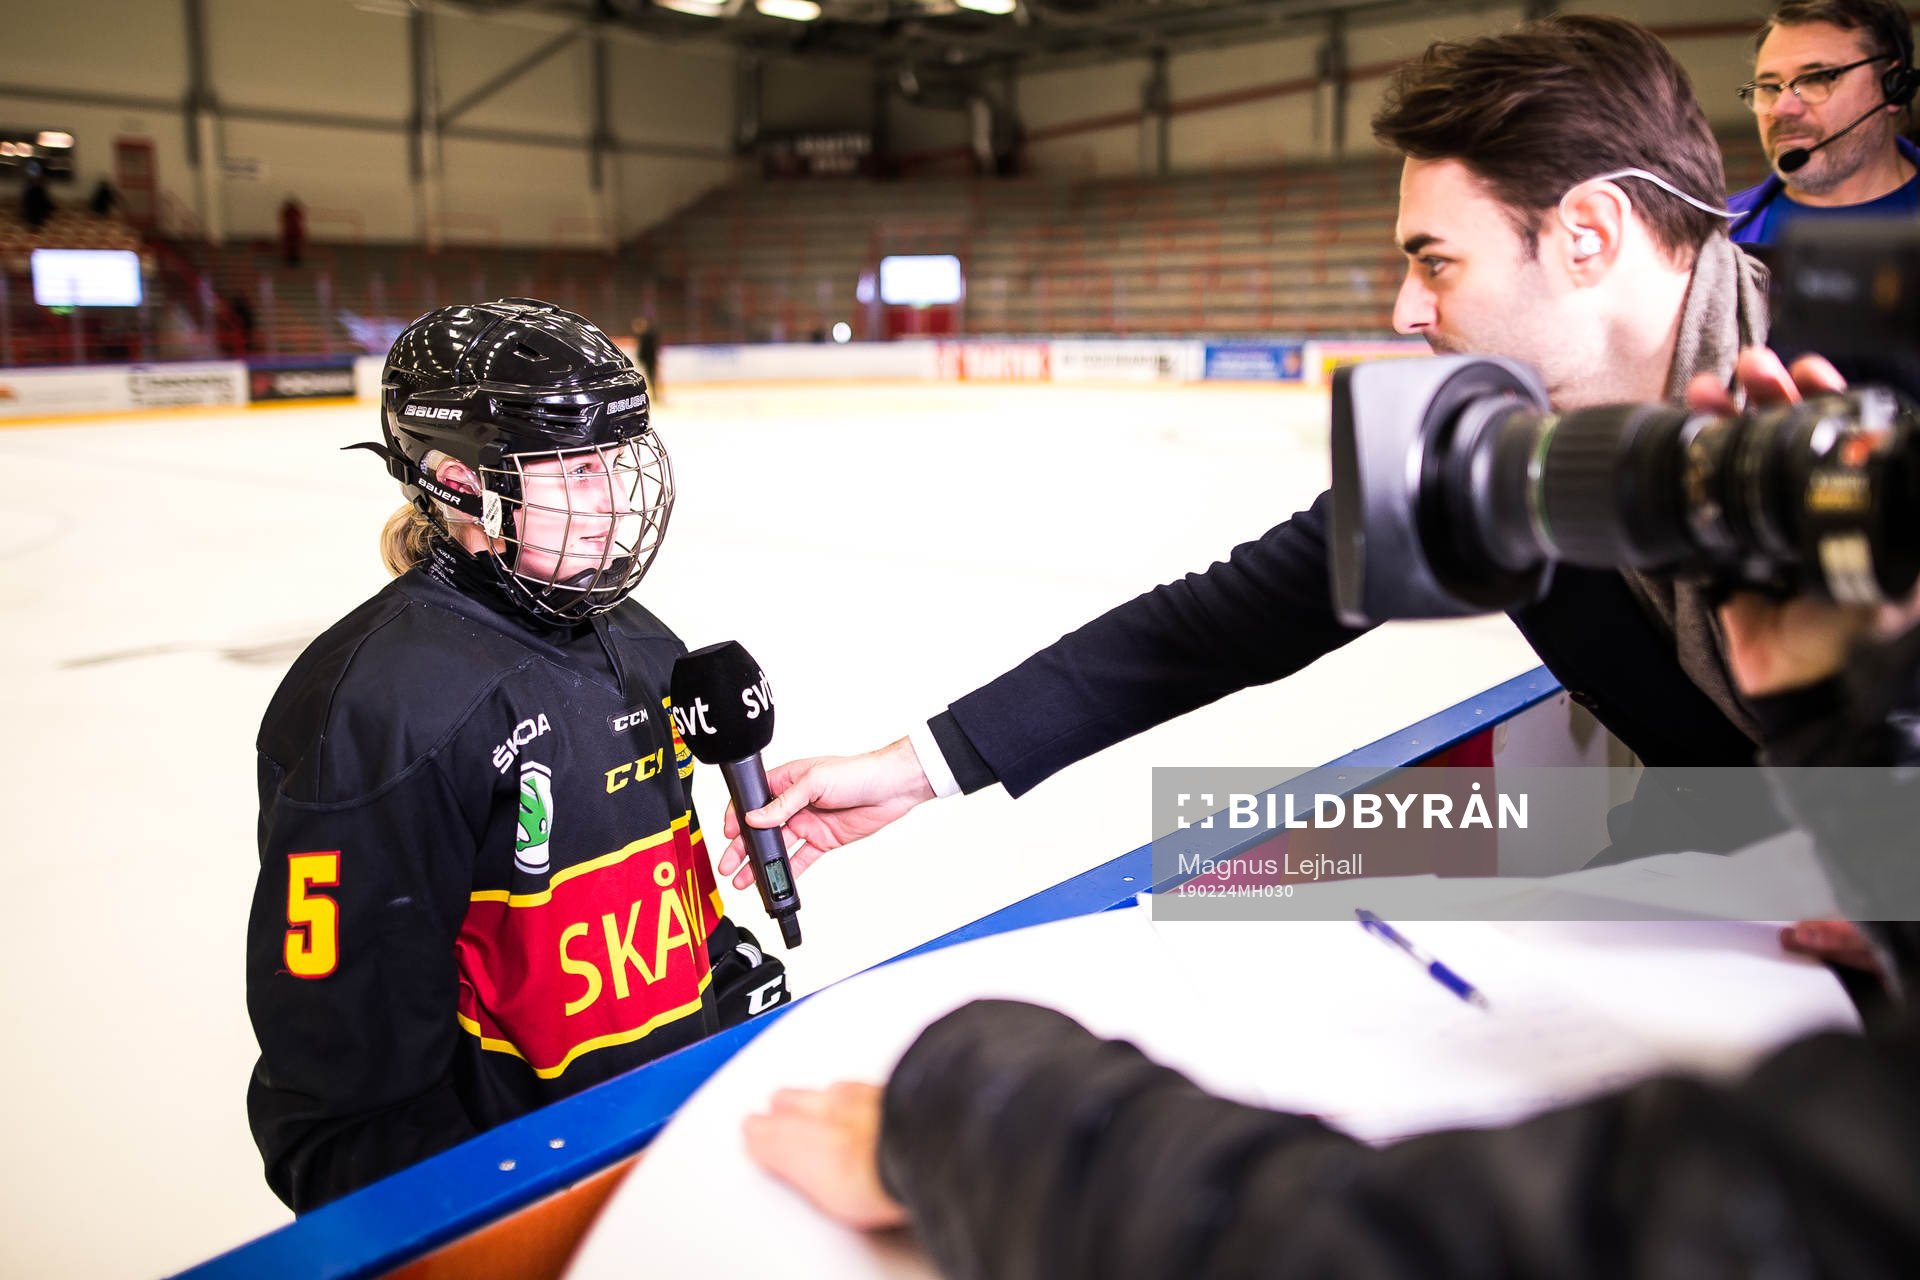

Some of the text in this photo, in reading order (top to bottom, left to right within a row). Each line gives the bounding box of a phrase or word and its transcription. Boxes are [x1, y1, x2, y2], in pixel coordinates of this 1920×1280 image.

[404, 404, 463, 421] BAUER
[607, 393, 647, 415] BAUER
[418, 477, 462, 506] BAUER
[612, 707, 649, 732] CCM
[672, 697, 718, 736] svt
[283, 850, 342, 980] 5
